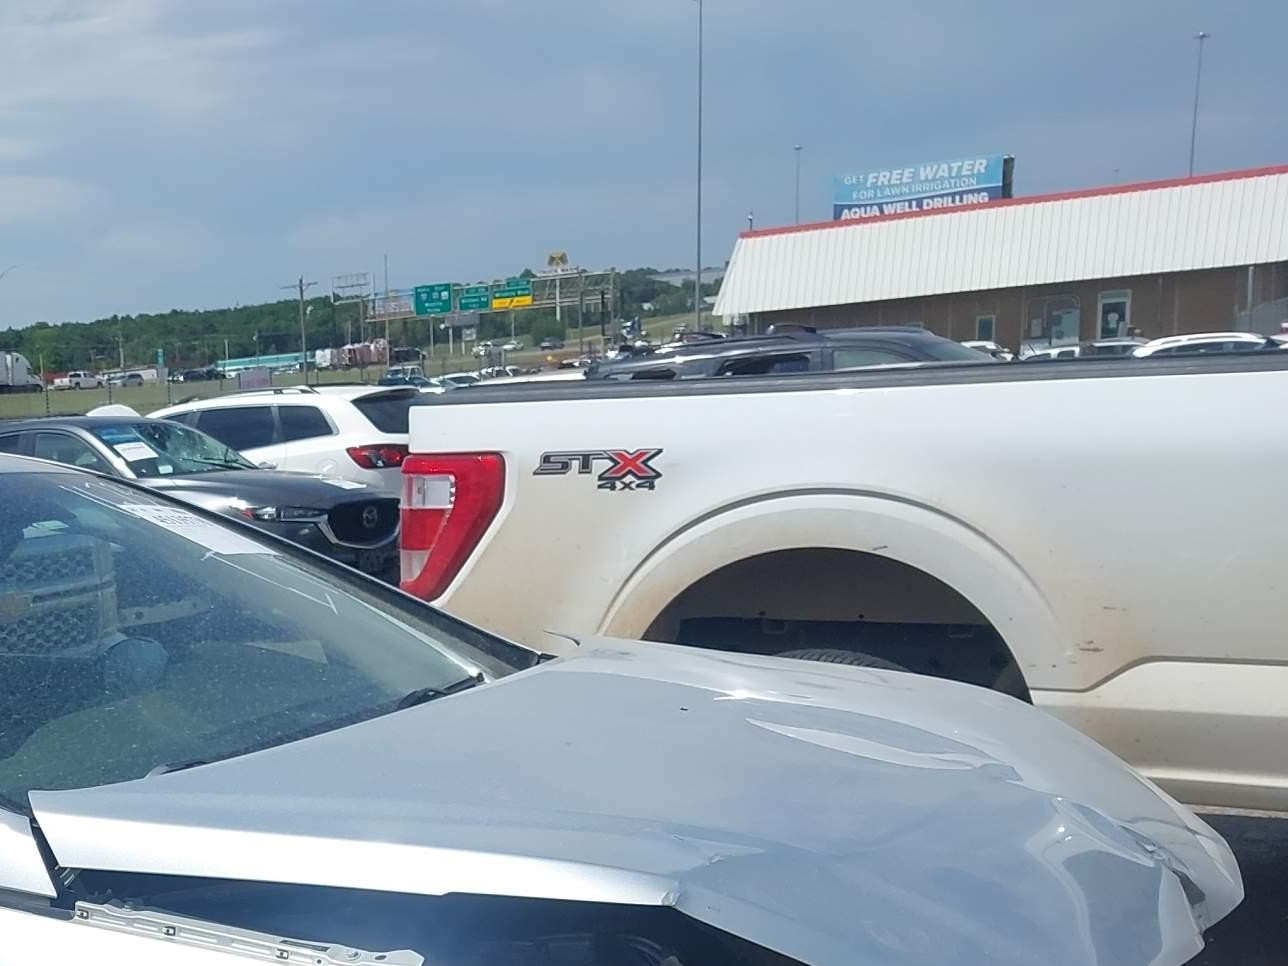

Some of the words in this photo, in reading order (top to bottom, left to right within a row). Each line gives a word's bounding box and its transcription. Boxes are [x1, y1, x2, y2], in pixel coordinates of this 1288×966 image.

[844, 174, 864, 185] GET
[866, 167, 915, 188] FREE
[919, 159, 988, 181] WATER
[852, 189, 875, 201] FOR
[876, 184, 910, 198] LAWN
[911, 176, 977, 194] IRRIGATION
[840, 205, 881, 221] AQUA
[882, 199, 920, 216] WELL
[922, 191, 989, 210] DRILLING
[533, 448, 664, 482] STX
